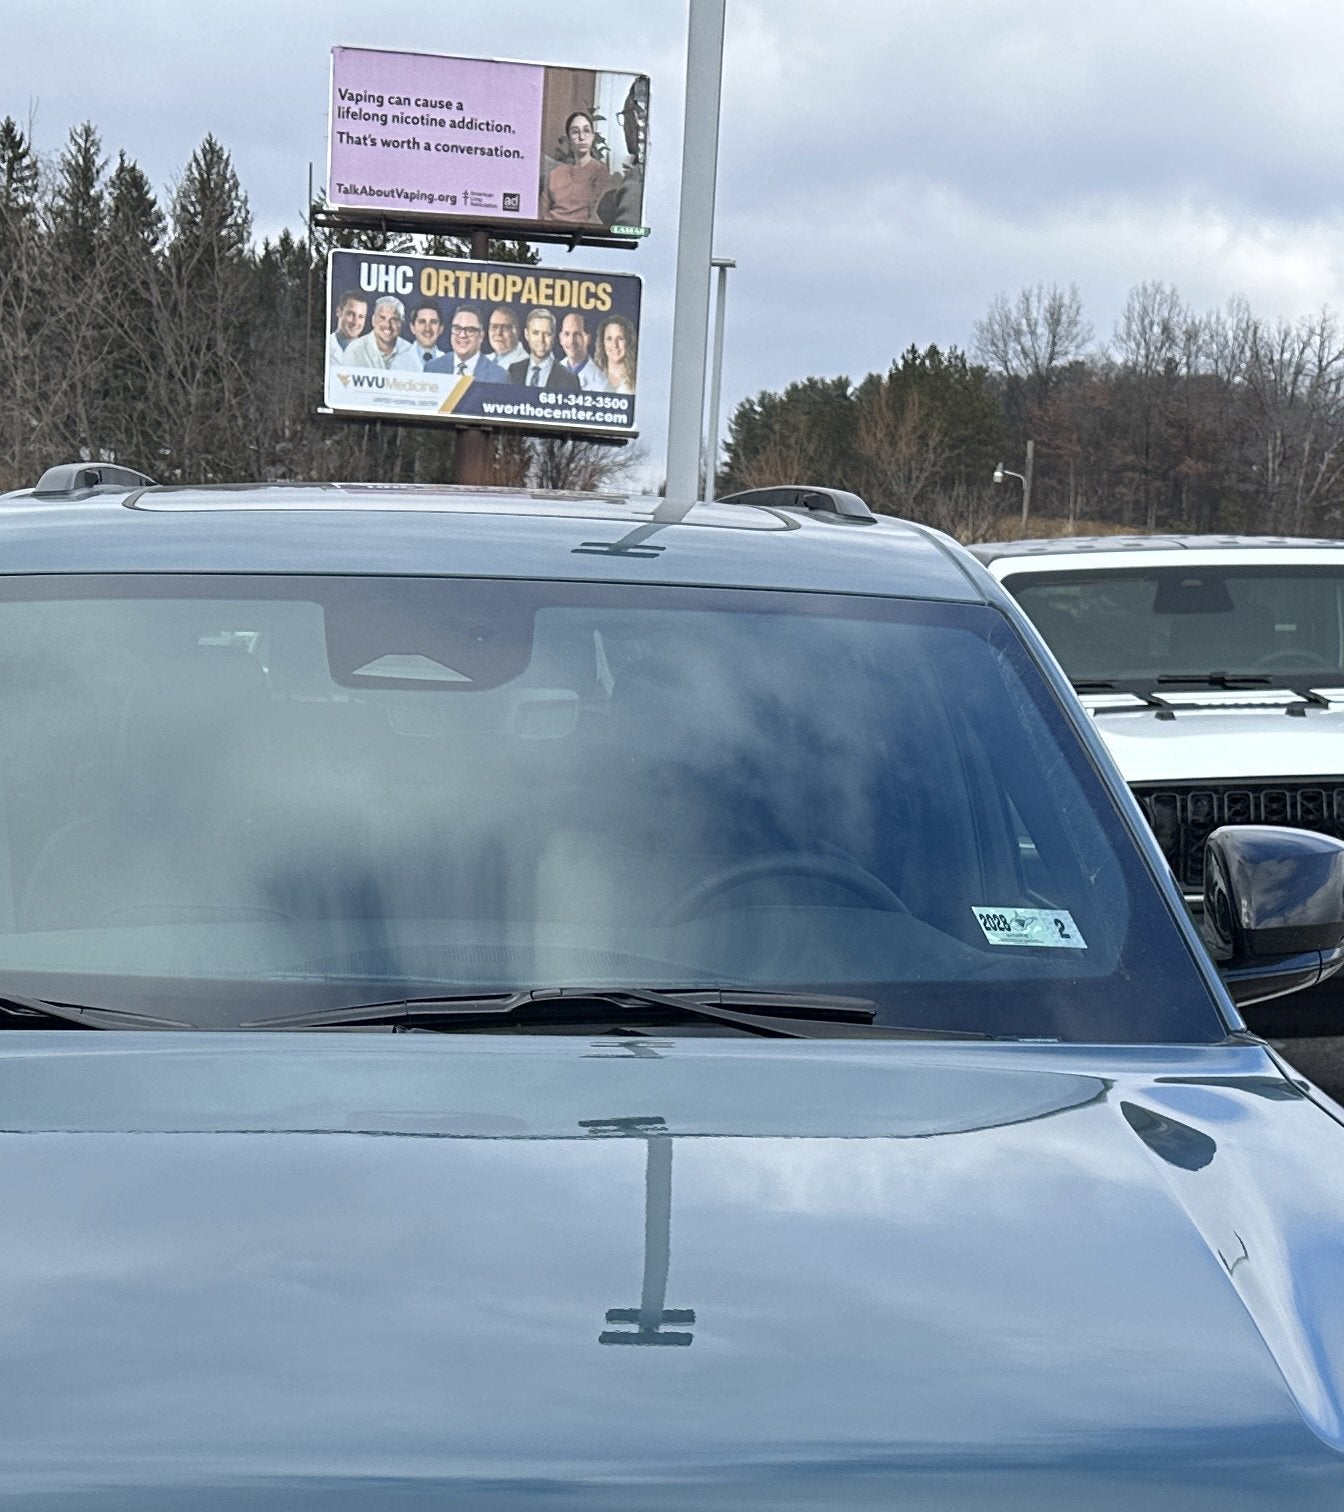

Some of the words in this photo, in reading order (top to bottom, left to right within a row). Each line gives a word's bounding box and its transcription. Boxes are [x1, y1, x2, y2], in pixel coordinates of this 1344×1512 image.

[338, 88, 384, 107] Vaping
[388, 95, 411, 106] can
[414, 97, 453, 110] cause
[456, 101, 464, 111] a
[337, 106, 388, 126] lifelong
[391, 112, 446, 128] nicotine
[449, 117, 516, 134] addiction.
[336, 131, 377, 147] That's
[380, 136, 420, 151] worth
[423, 142, 432, 152] a
[434, 142, 525, 160] conversation.
[336, 183, 457, 206] TalkAboutVaping.org
[359, 262, 414, 294] UHC
[420, 267, 612, 311] ORTHOPAEDICS
[538, 392, 629, 410] 681-342-3500
[482, 403, 628, 424] wvorthocenter.com
[1054, 918, 1071, 939] 2
